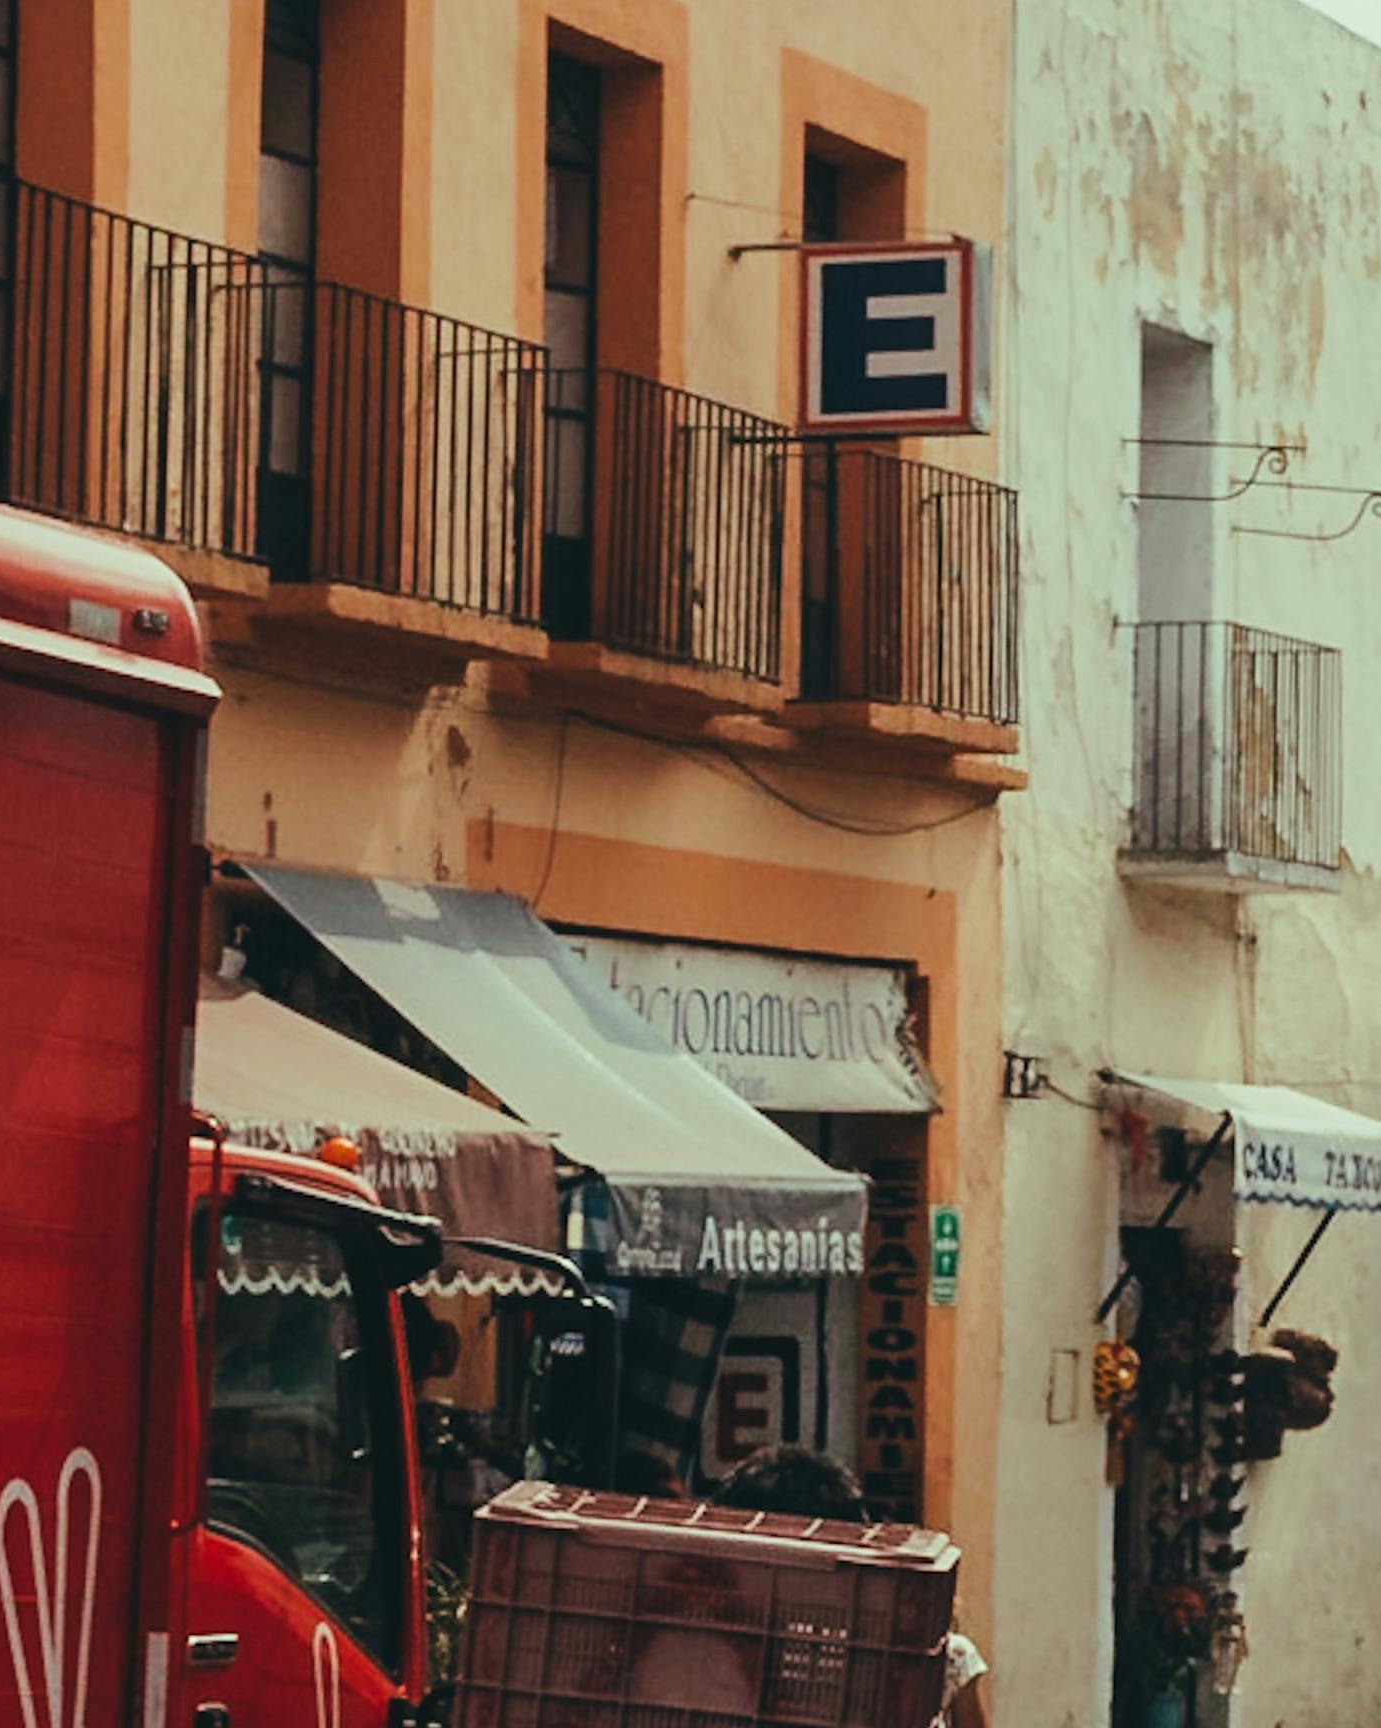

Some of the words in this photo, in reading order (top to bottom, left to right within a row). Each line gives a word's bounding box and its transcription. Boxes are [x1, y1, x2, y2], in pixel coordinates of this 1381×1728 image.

[820, 258, 947, 414] E
[1244, 1142, 1296, 1184] CASA
[697, 1214, 864, 1274] Artesanías
